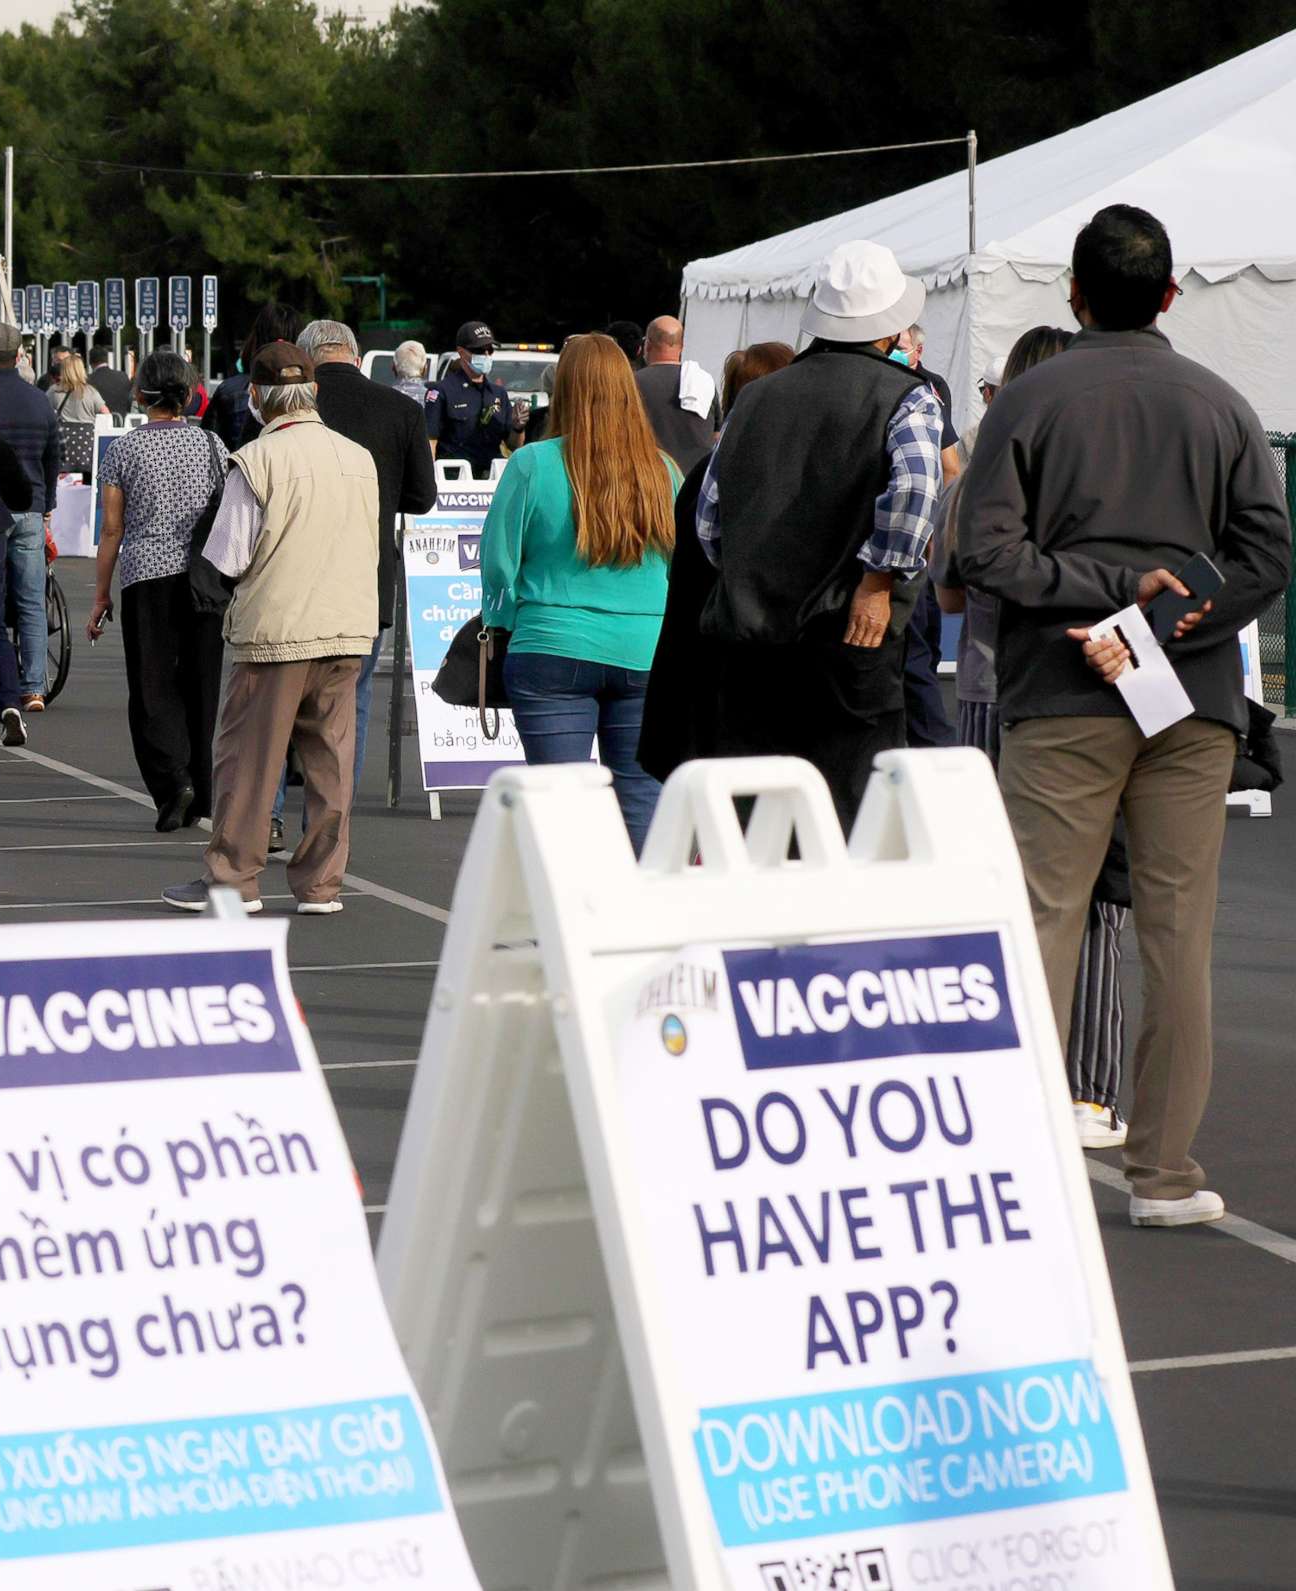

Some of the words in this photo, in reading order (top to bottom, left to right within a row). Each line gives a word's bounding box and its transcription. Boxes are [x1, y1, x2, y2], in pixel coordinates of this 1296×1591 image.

[438, 494, 494, 506] VACCIN
[409, 537, 456, 553] ANAHEIM
[481, 735, 520, 750] chuy
[738, 964, 1001, 1038] VACCINES
[8, 1134, 68, 1201] vị
[80, 1128, 150, 1188] có
[166, 1112, 319, 1197] phần
[700, 1091, 807, 1171] DO
[818, 1075, 973, 1159] YOU
[142, 1209, 266, 1278] ứng
[693, 1187, 883, 1277] HAVE
[890, 1172, 1031, 1254] THE
[136, 1283, 308, 1358] chưa?
[806, 1280, 960, 1370] APP?
[145, 1428, 252, 1476] NGAY
[700, 1389, 974, 1478] DOWNLOAD
[977, 1370, 1104, 1438] NOW
[738, 1476, 814, 1531] (USE
[816, 1458, 940, 1517] PHONE
[940, 1434, 1094, 1500] CAMERA)
[906, 1537, 990, 1586] CLICK
